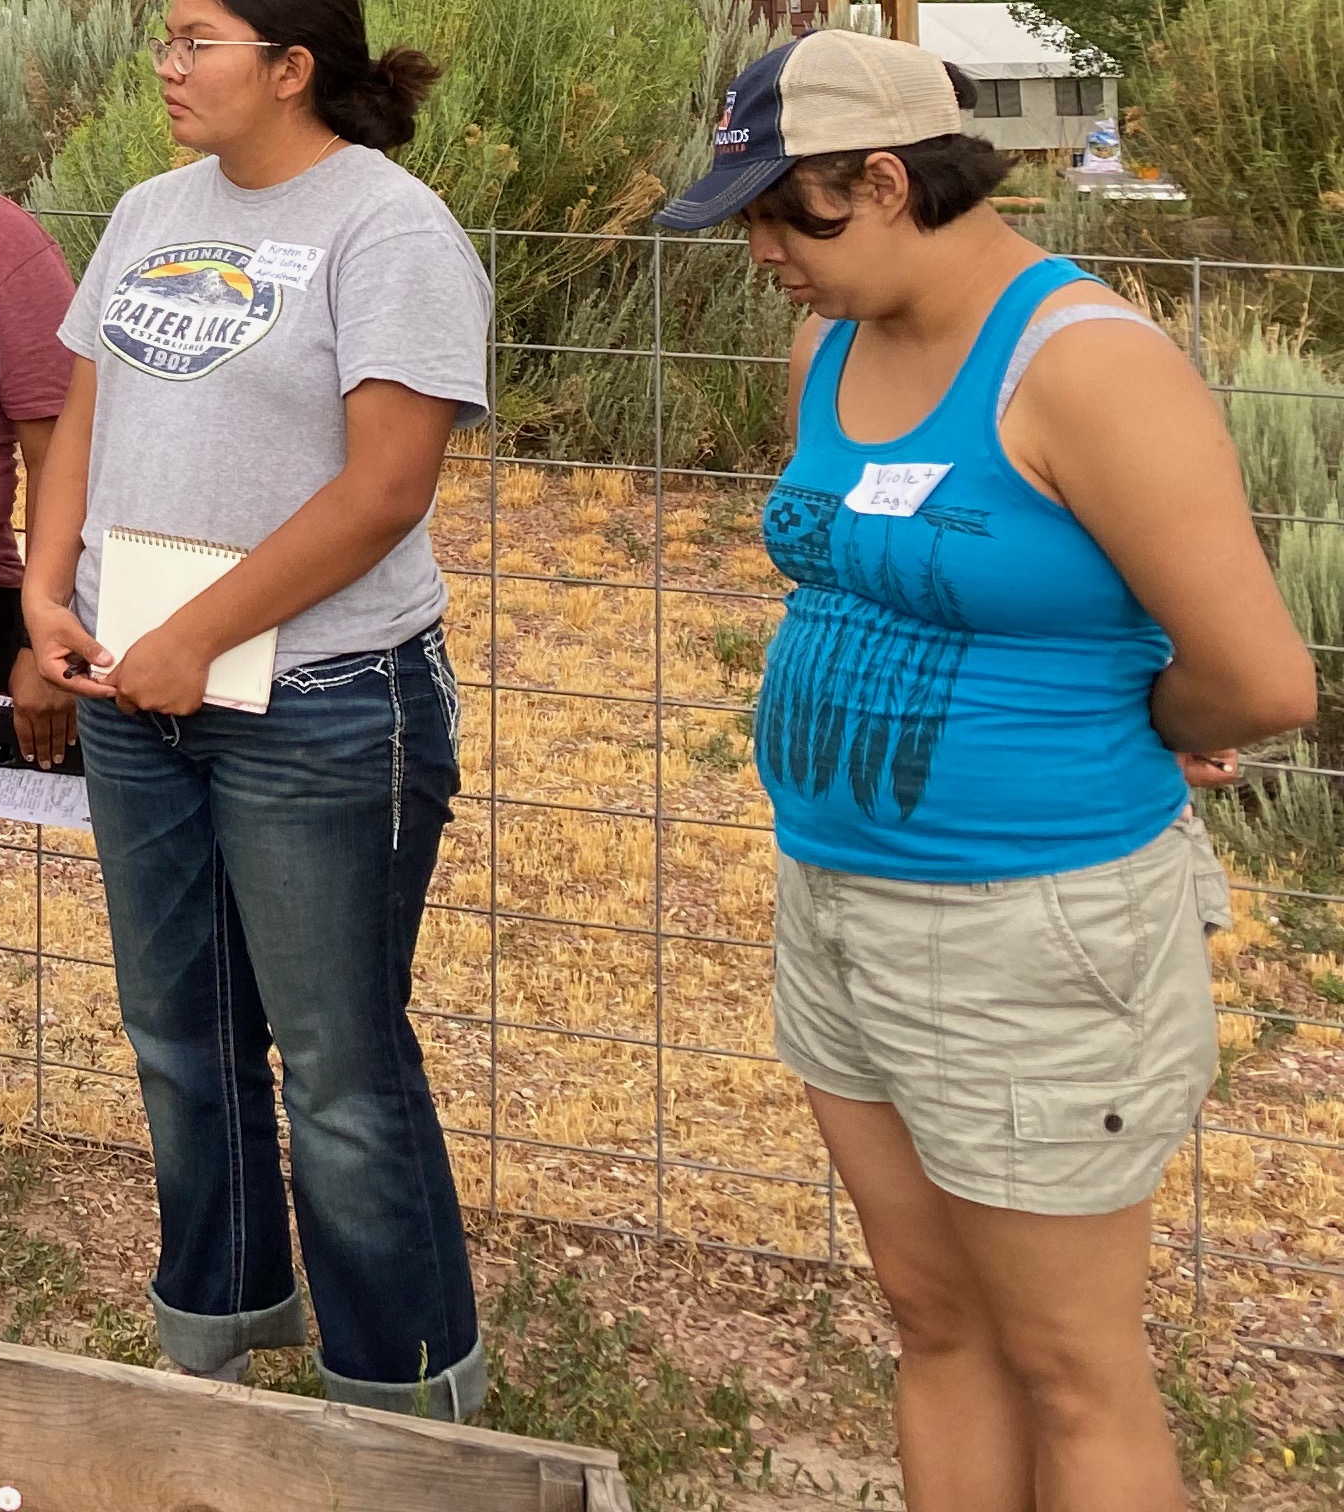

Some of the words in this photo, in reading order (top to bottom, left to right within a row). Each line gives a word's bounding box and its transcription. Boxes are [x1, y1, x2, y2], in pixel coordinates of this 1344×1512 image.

[137, 248, 235, 275] NATIONAL
[104, 298, 193, 340] CRATER
[195, 316, 251, 345] LAKE
[130, 328, 204, 352] ESTABLISHED
[143, 347, 192, 374] 1902
